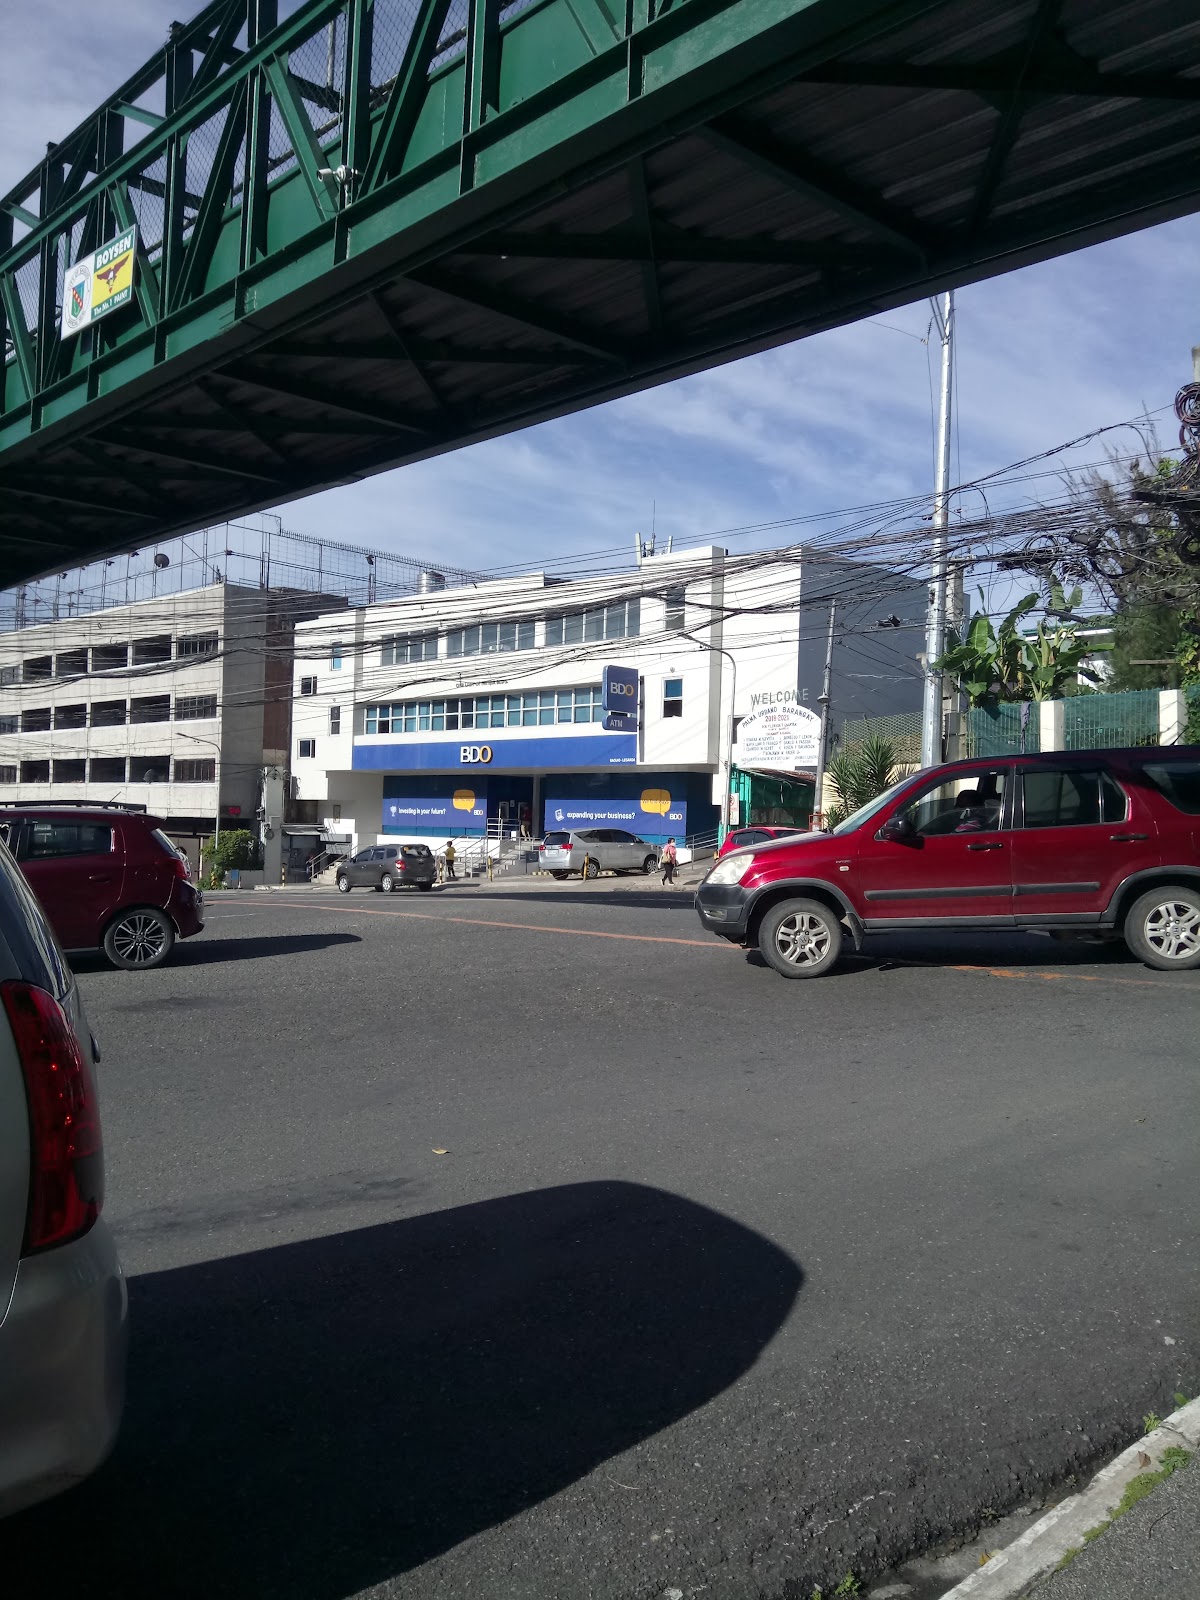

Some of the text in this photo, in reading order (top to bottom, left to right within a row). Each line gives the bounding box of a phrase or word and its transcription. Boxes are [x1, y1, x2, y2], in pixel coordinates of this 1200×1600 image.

[97, 234, 132, 269] BOYSEN
[94, 307, 103, 316] The
[114, 290, 128, 304] PAINT
[610, 682, 634, 696] BDO
[751, 689, 809, 706] WELCOME
[782, 706, 815, 722] BARANGAY
[610, 719, 623, 728] ATM
[460, 745, 492, 763] BDO
[420, 808, 431, 816] your
[430, 807, 447, 815] future?
[566, 811, 594, 820] expanding
[607, 811, 636, 820] business?
